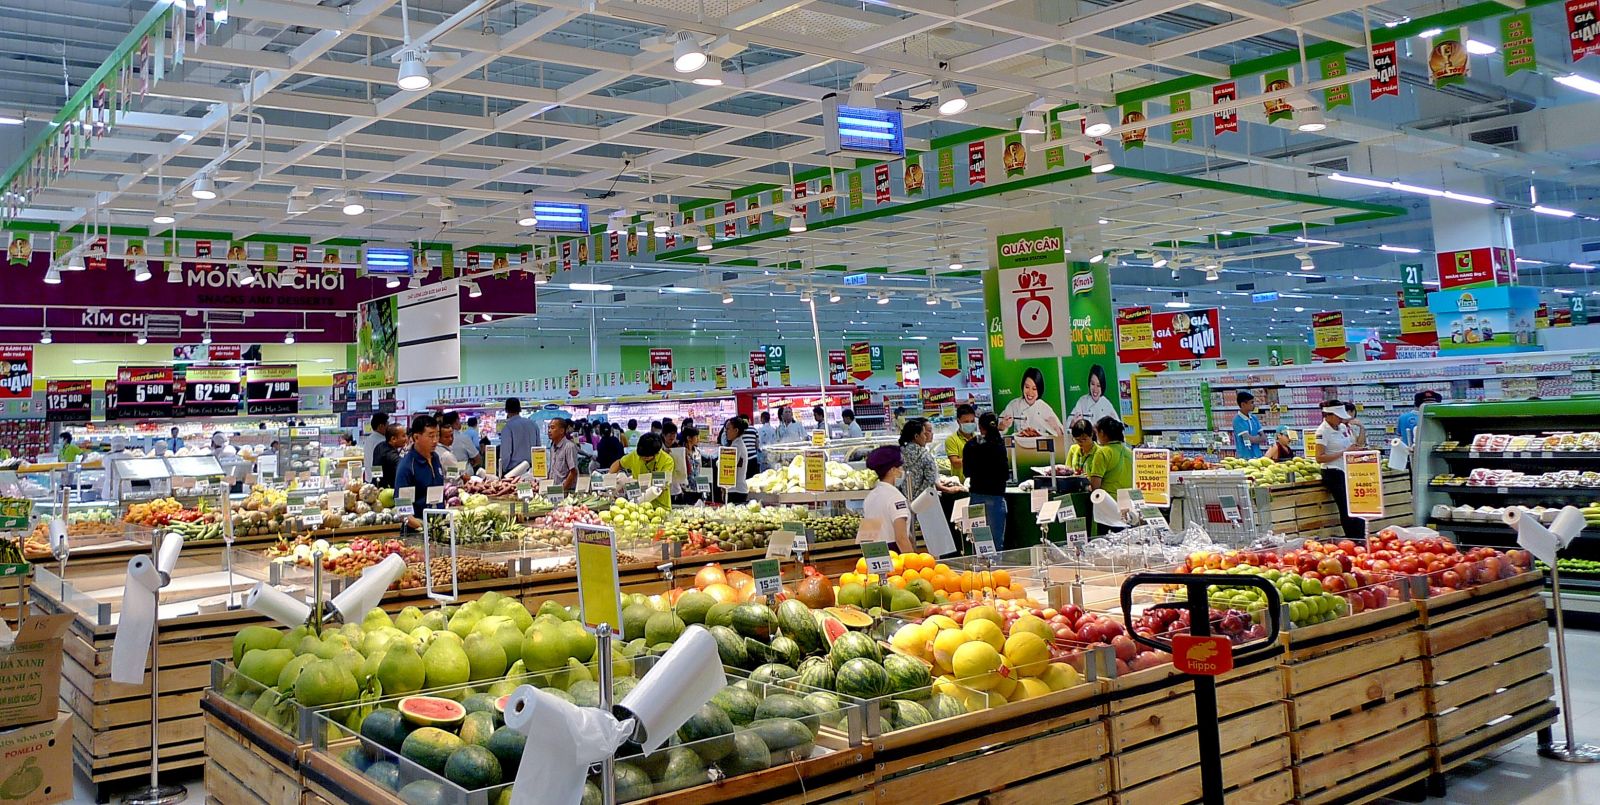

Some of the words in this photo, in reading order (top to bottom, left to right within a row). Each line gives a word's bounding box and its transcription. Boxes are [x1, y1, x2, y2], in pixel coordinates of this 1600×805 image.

[1574, 11, 1595, 23] GIÁ
[1375, 56, 1391, 66] GIÁ
[1035, 236, 1059, 251] CÂN
[187, 266, 242, 288] MÓN
[250, 267, 282, 288] ĂN
[1406, 267, 1418, 284] 21
[1572, 297, 1583, 311] 23
[82, 312, 114, 326] KIM
[119, 313, 145, 326] CH
[1072, 315, 1091, 331] quyết
[1191, 313, 1209, 326] GIÁ
[1156, 327, 1172, 338] GIÁ
[991, 334, 1004, 348] NG
[1180, 328, 1215, 355] GIẢM
[768, 346, 782, 358] 20
[871, 346, 880, 357] 19
[11, 362, 28, 371] GIÁ
[0, 372, 32, 392] GIẢM
[136, 384, 146, 402] 5
[147, 384, 164, 394] 500
[195, 383, 213, 401] 62
[213, 383, 231, 393] 500
[265, 382, 274, 399] 7
[47, 394, 68, 409] 125
[871, 561, 882, 569] 31
[759, 580, 769, 590] 15
[17, 658, 45, 668] XANH
[1187, 660, 1217, 672] Hippo
[4, 743, 43, 759] POMELO
